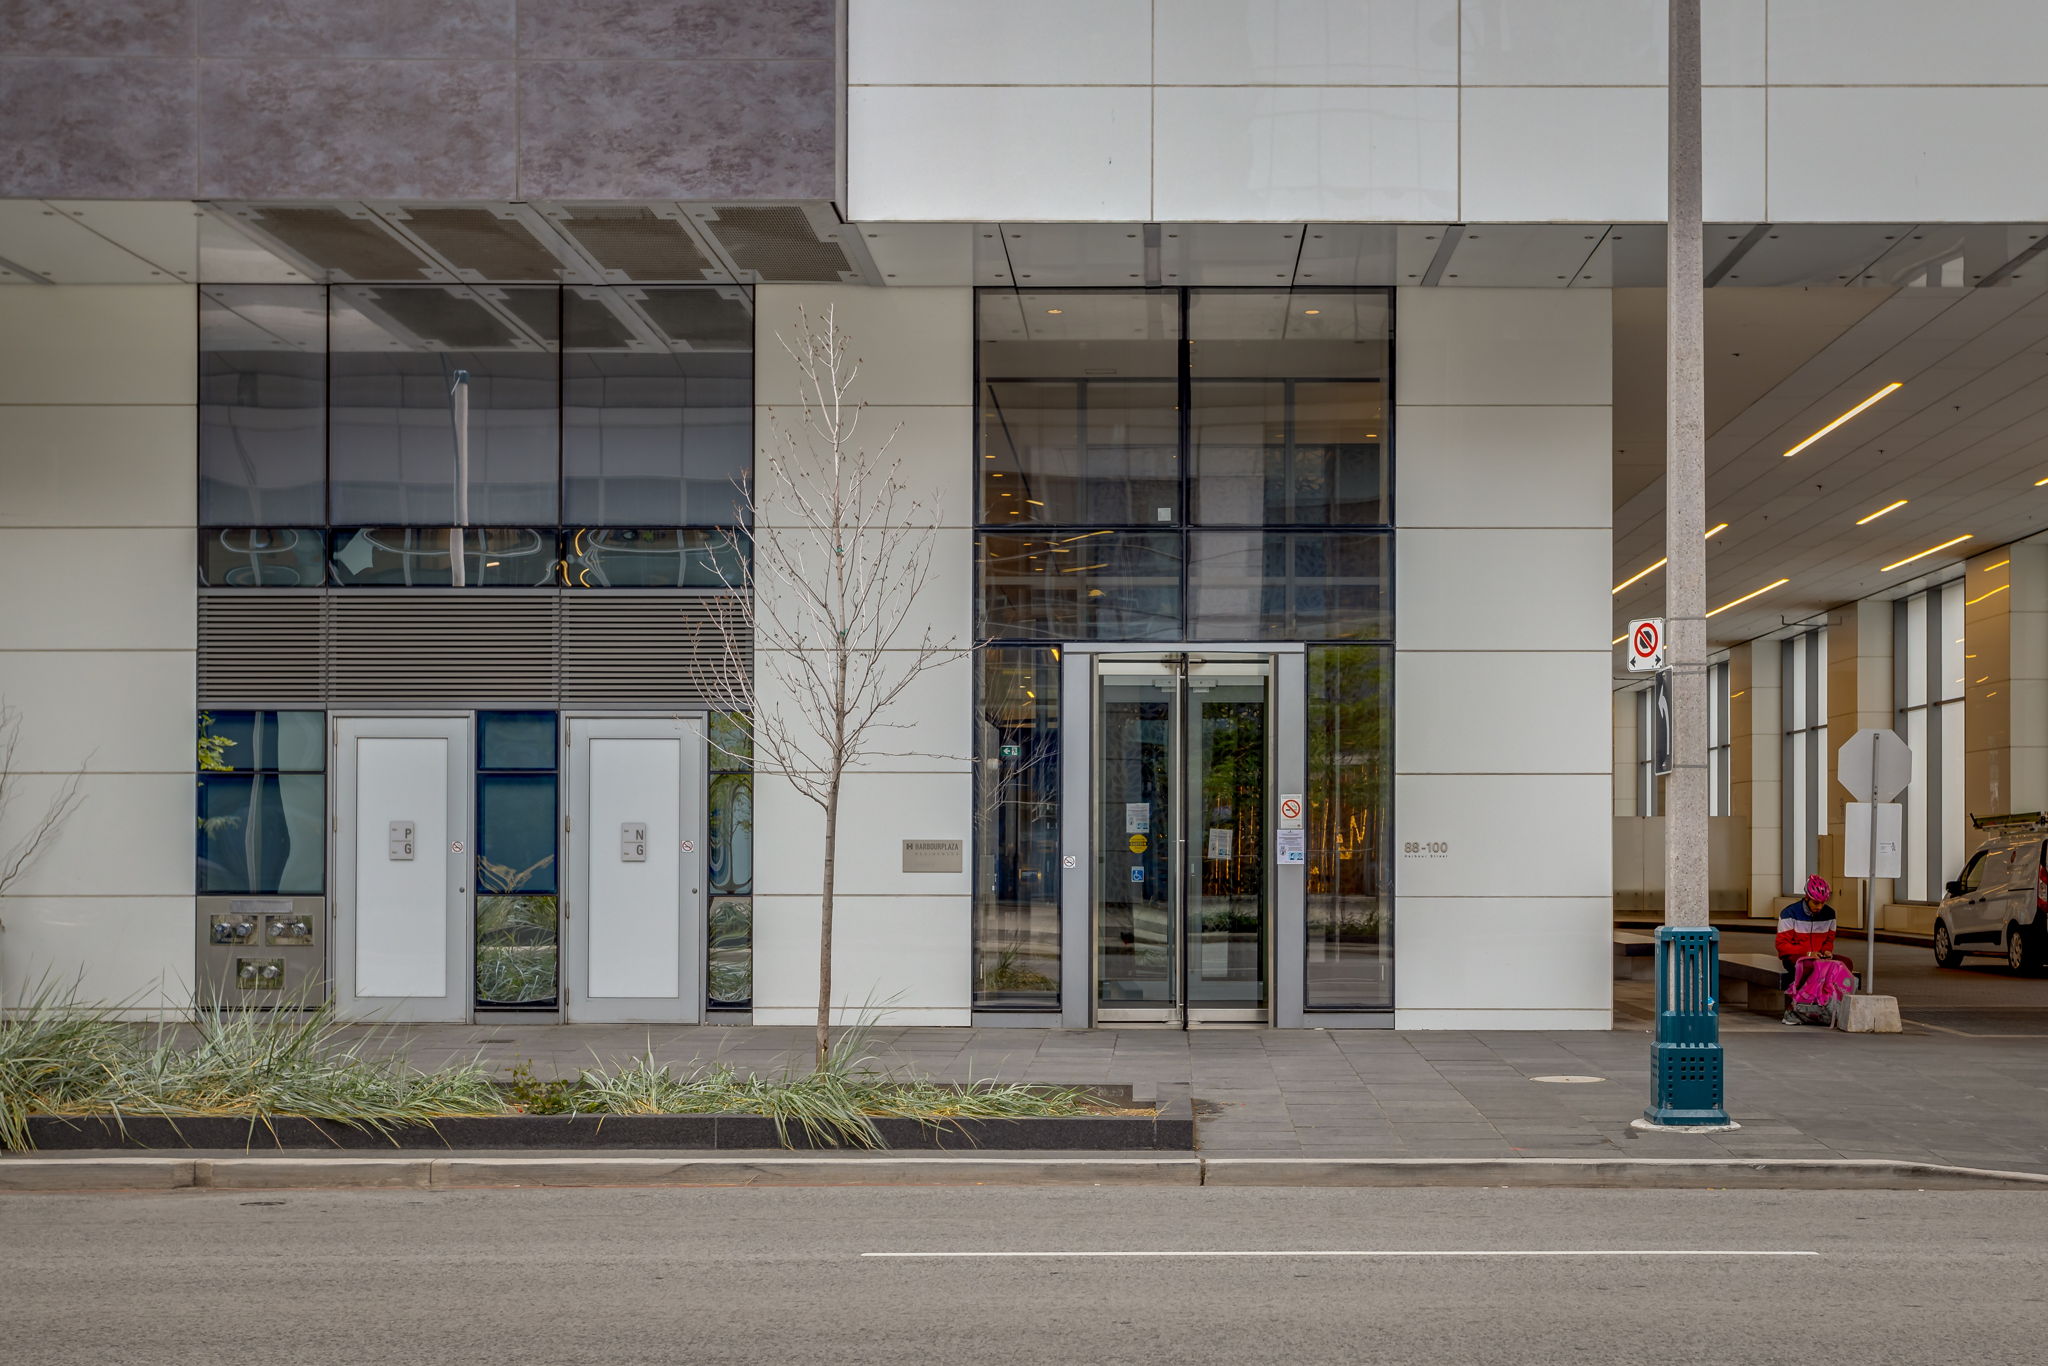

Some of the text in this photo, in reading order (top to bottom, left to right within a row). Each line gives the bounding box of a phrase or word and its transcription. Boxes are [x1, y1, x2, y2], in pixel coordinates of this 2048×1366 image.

[404, 828, 412, 839] P
[636, 829, 644, 841] N
[404, 843, 412, 854] G
[636, 844, 644, 856] G
[1404, 842, 1448, 853] 88-100
